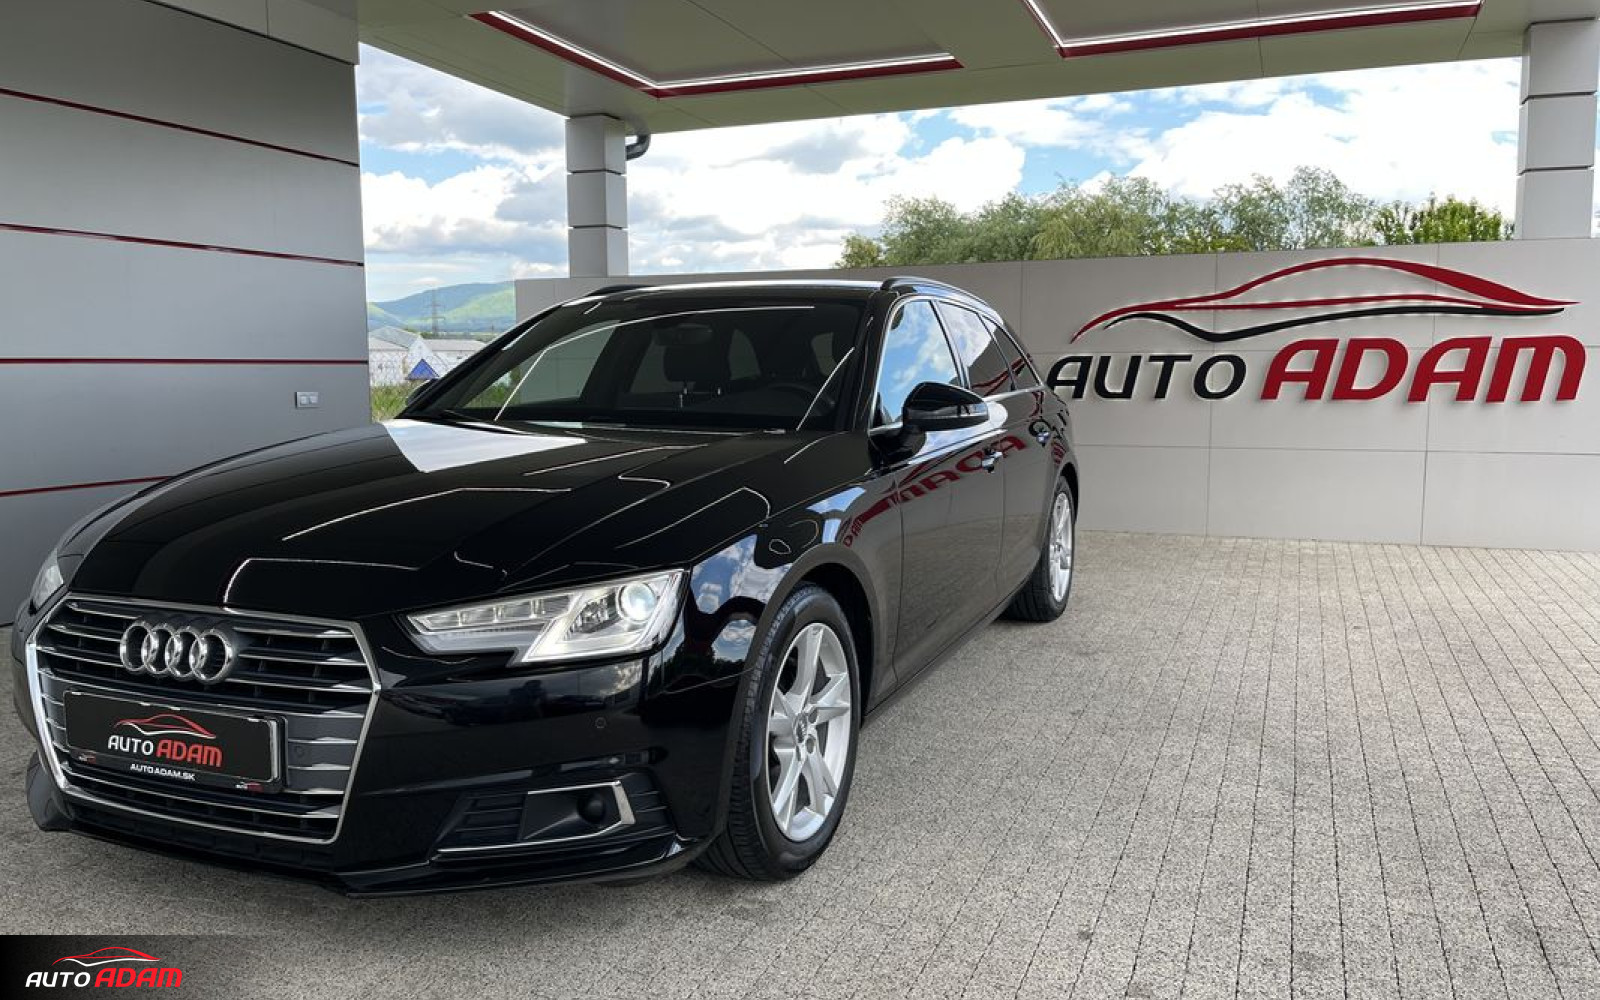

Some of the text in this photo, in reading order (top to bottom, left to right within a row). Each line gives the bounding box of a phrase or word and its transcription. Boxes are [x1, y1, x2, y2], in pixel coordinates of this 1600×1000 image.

[1046, 335, 1586, 403] AUTO ADAM
[107, 735, 223, 768] AUTO ADAM
